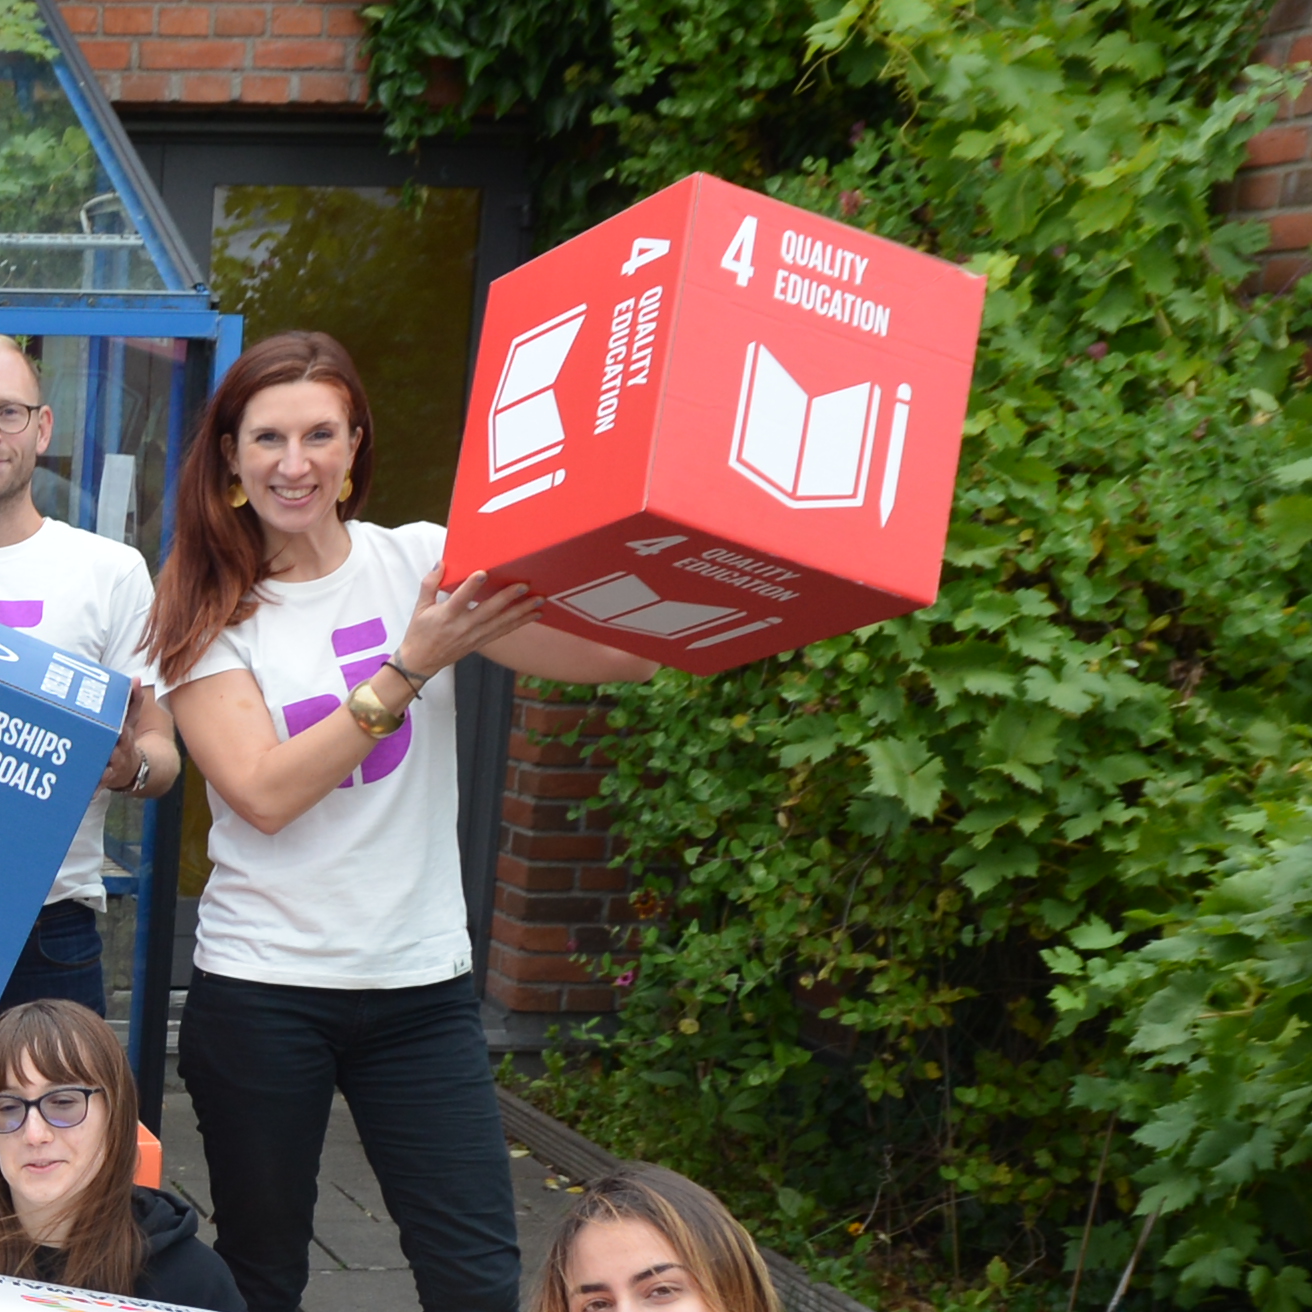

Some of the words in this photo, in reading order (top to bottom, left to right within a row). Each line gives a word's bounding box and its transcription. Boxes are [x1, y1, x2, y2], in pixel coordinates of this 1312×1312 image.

[620, 236, 672, 277] 4
[720, 215, 759, 286] 4
[780, 229, 869, 287] QUALITY
[625, 285, 664, 387] QUALITY
[773, 270, 891, 338] EDUCATION
[593, 297, 637, 436] EDUCATION
[624, 535, 690, 556] 4
[700, 547, 802, 583] QUALITY
[673, 557, 800, 603] EDUCATION
